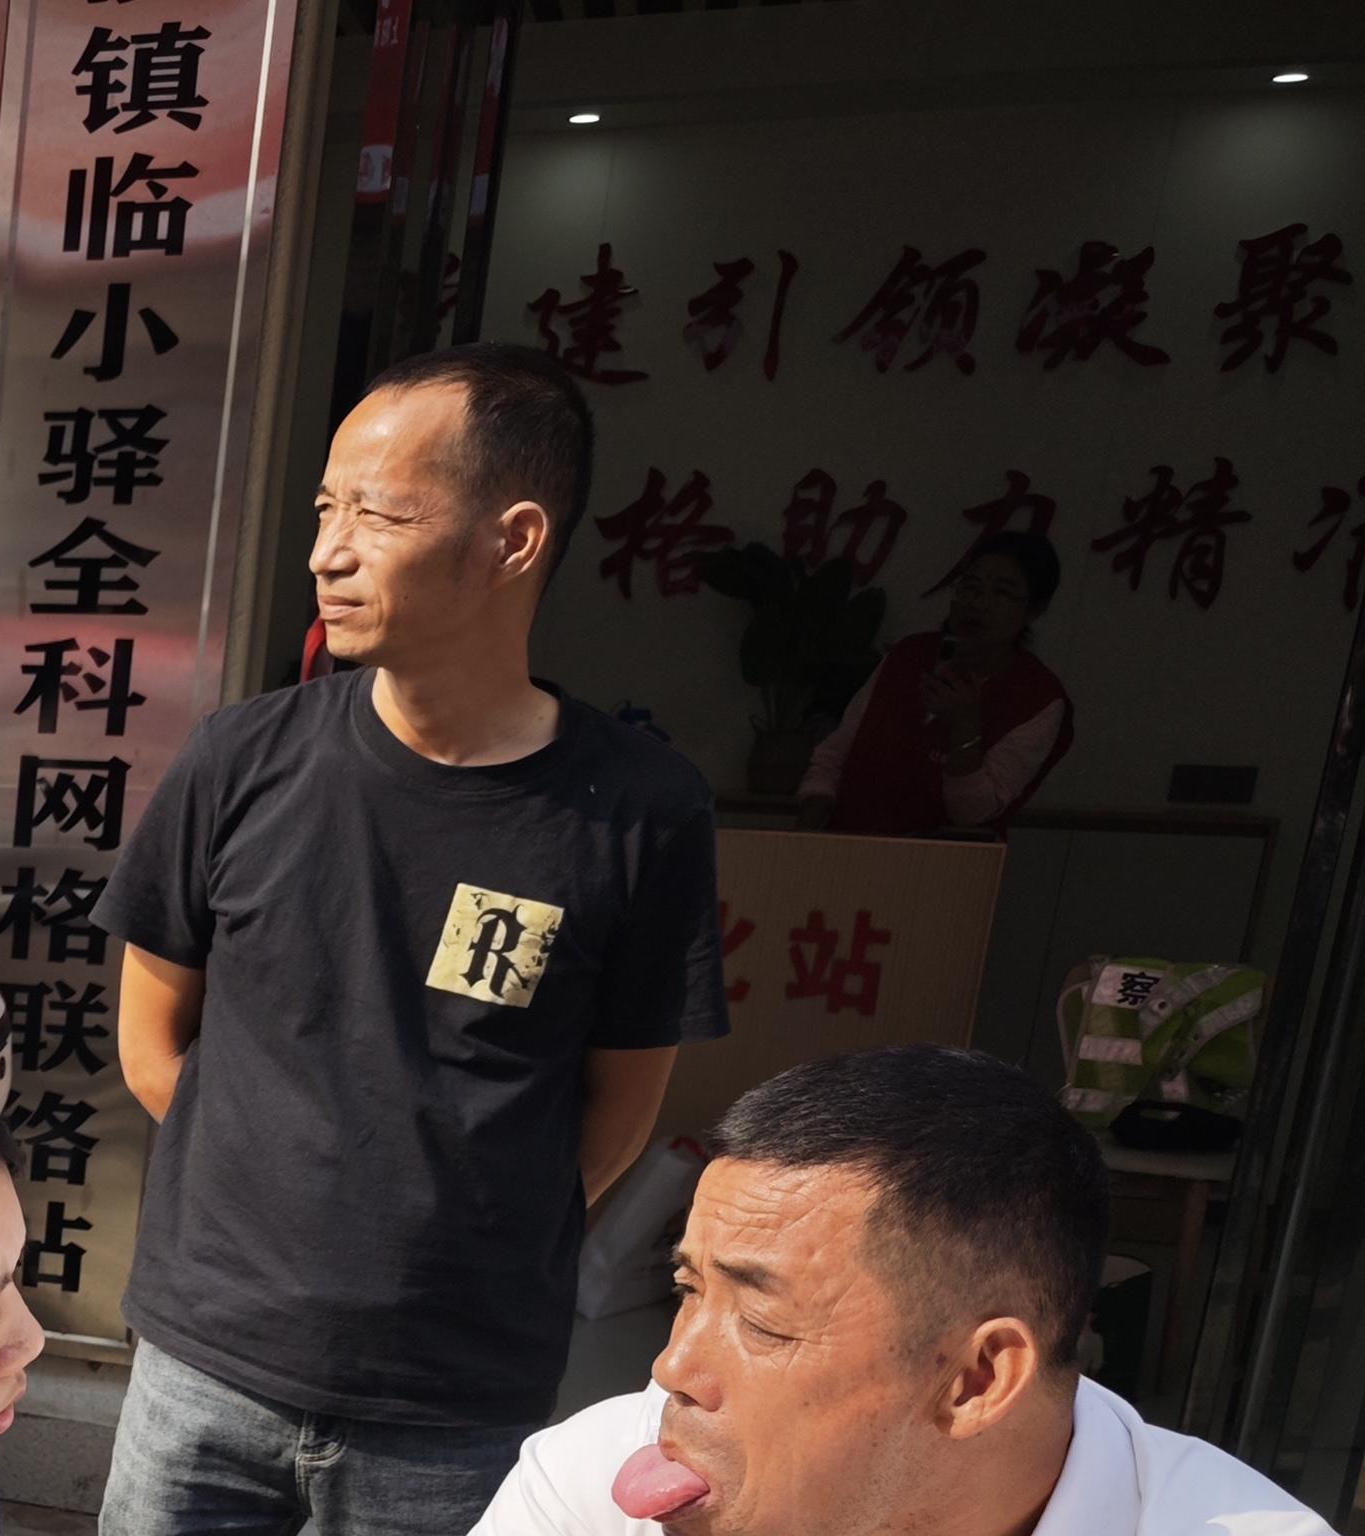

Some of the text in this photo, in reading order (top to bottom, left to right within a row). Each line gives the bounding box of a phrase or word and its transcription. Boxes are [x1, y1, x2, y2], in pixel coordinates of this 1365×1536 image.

[404, 222, 1355, 387] 建引领凝聚
[1116, 968, 1160, 1008] 察
